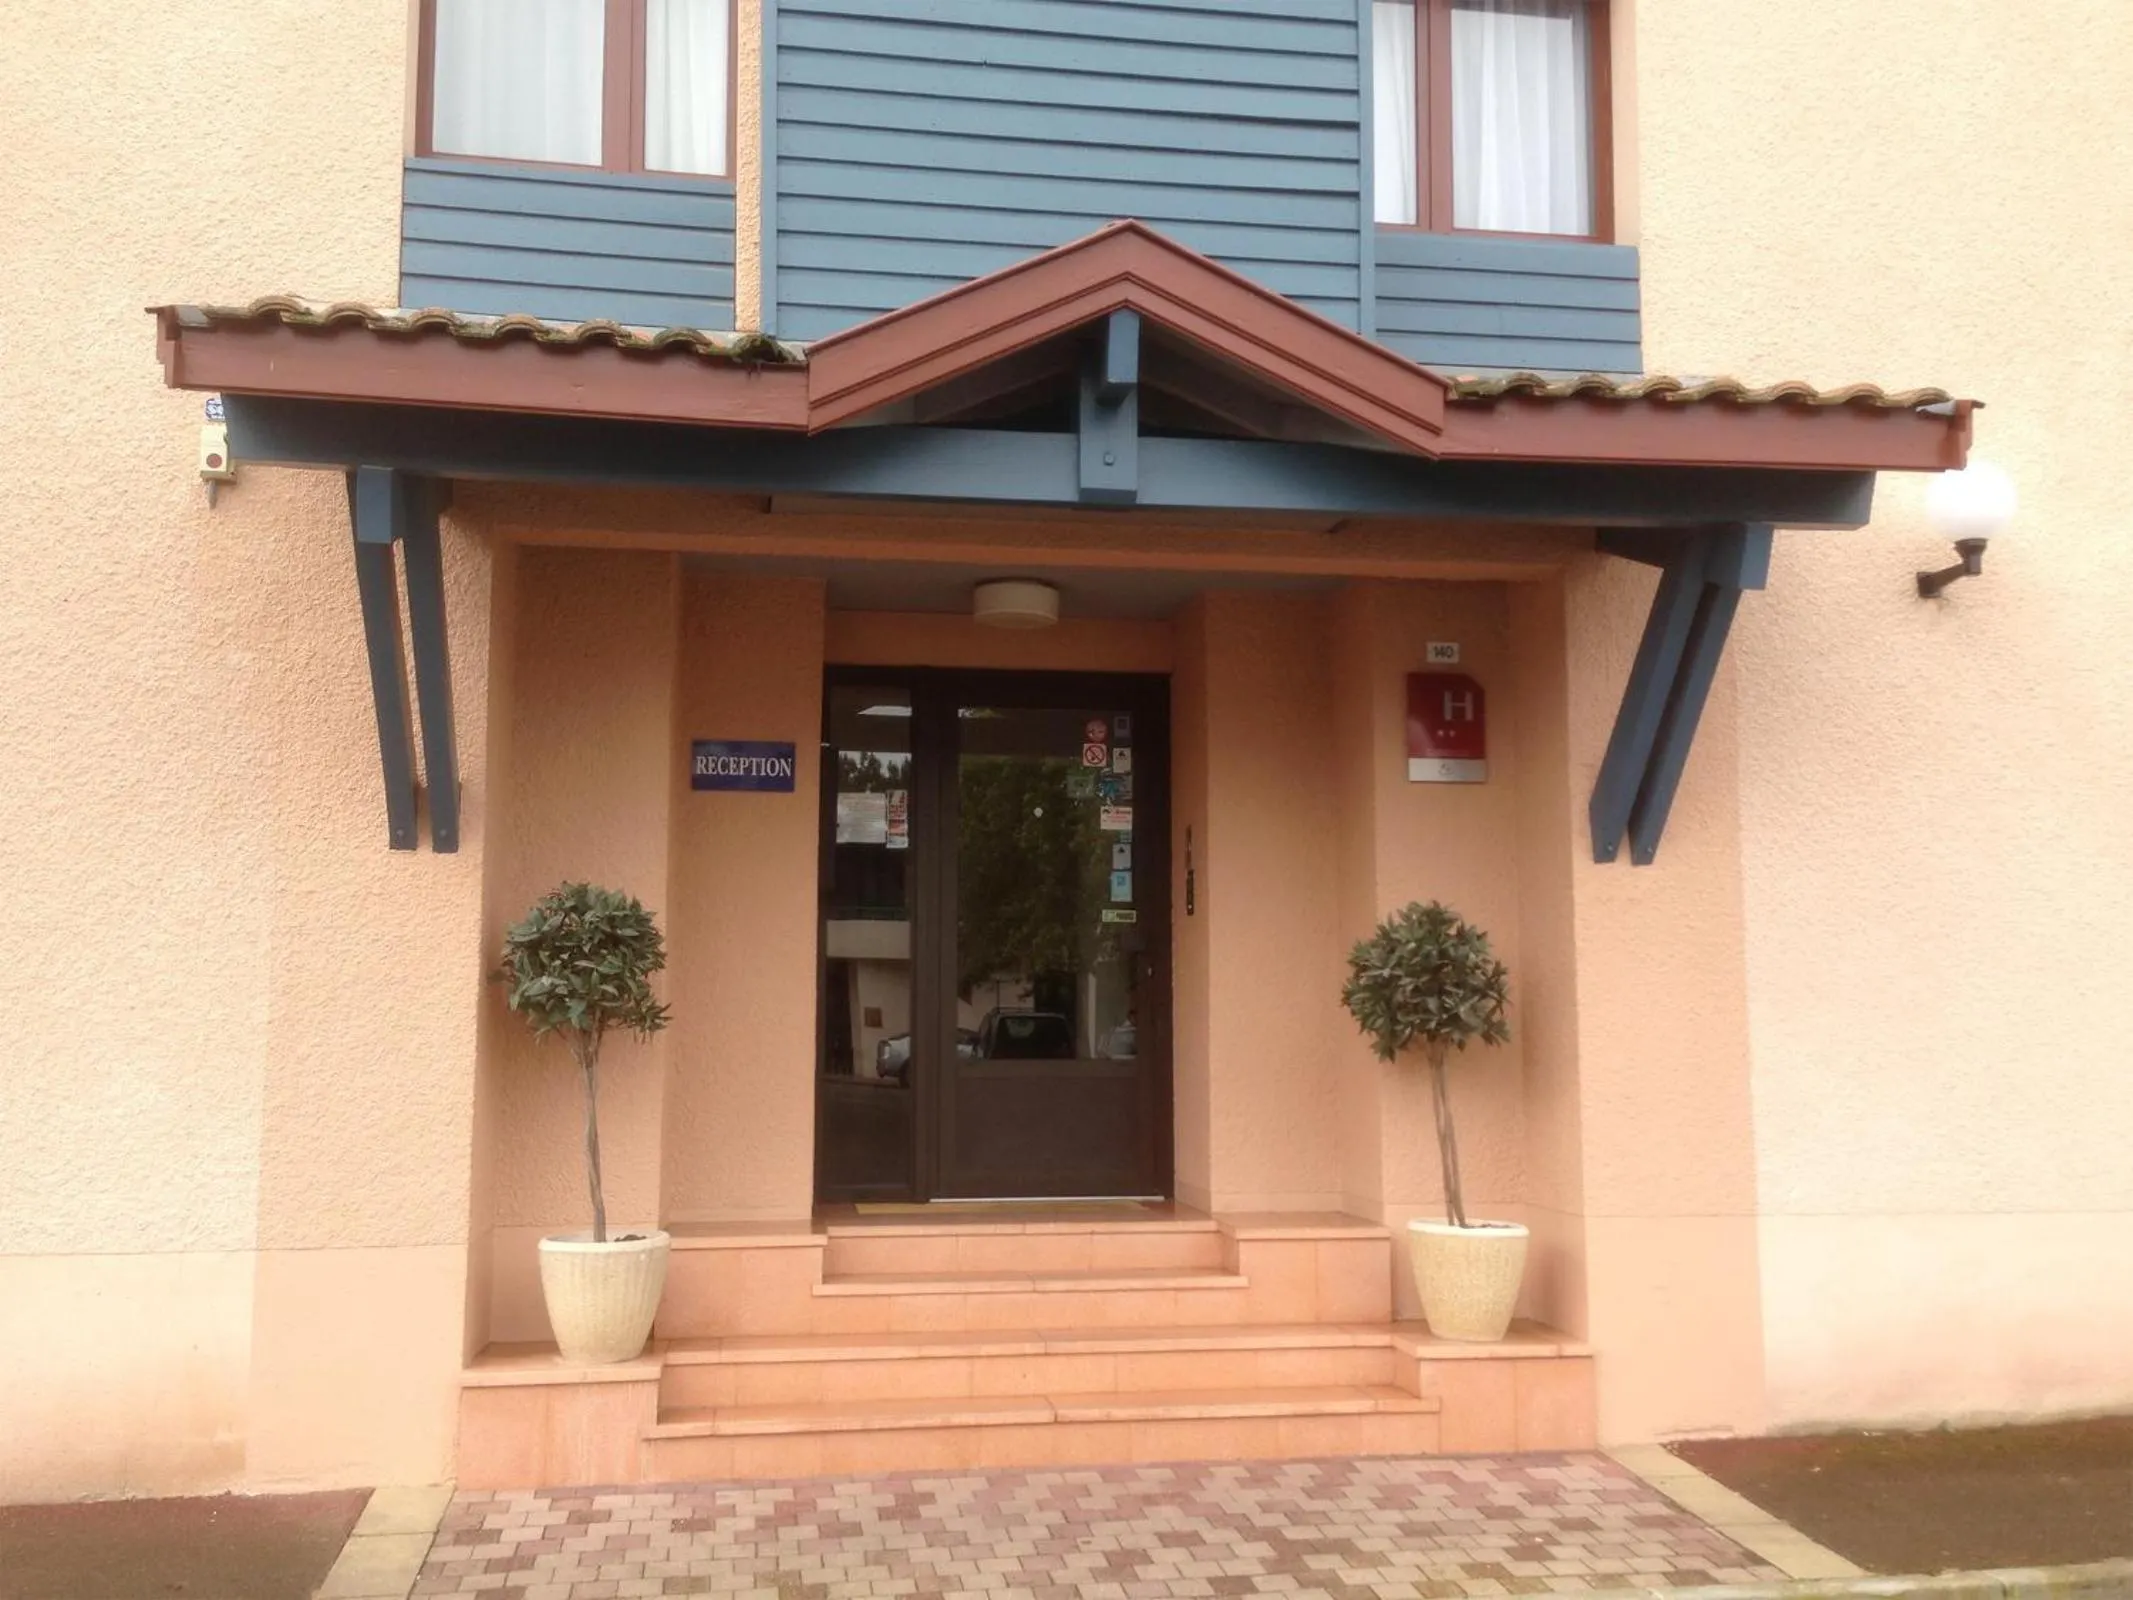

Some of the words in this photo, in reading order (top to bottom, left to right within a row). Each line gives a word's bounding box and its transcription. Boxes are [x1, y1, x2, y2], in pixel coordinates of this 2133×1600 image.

[1433, 646, 1454, 659] 140
[1443, 691, 1474, 721] H
[696, 755, 792, 778] RECEPTION
